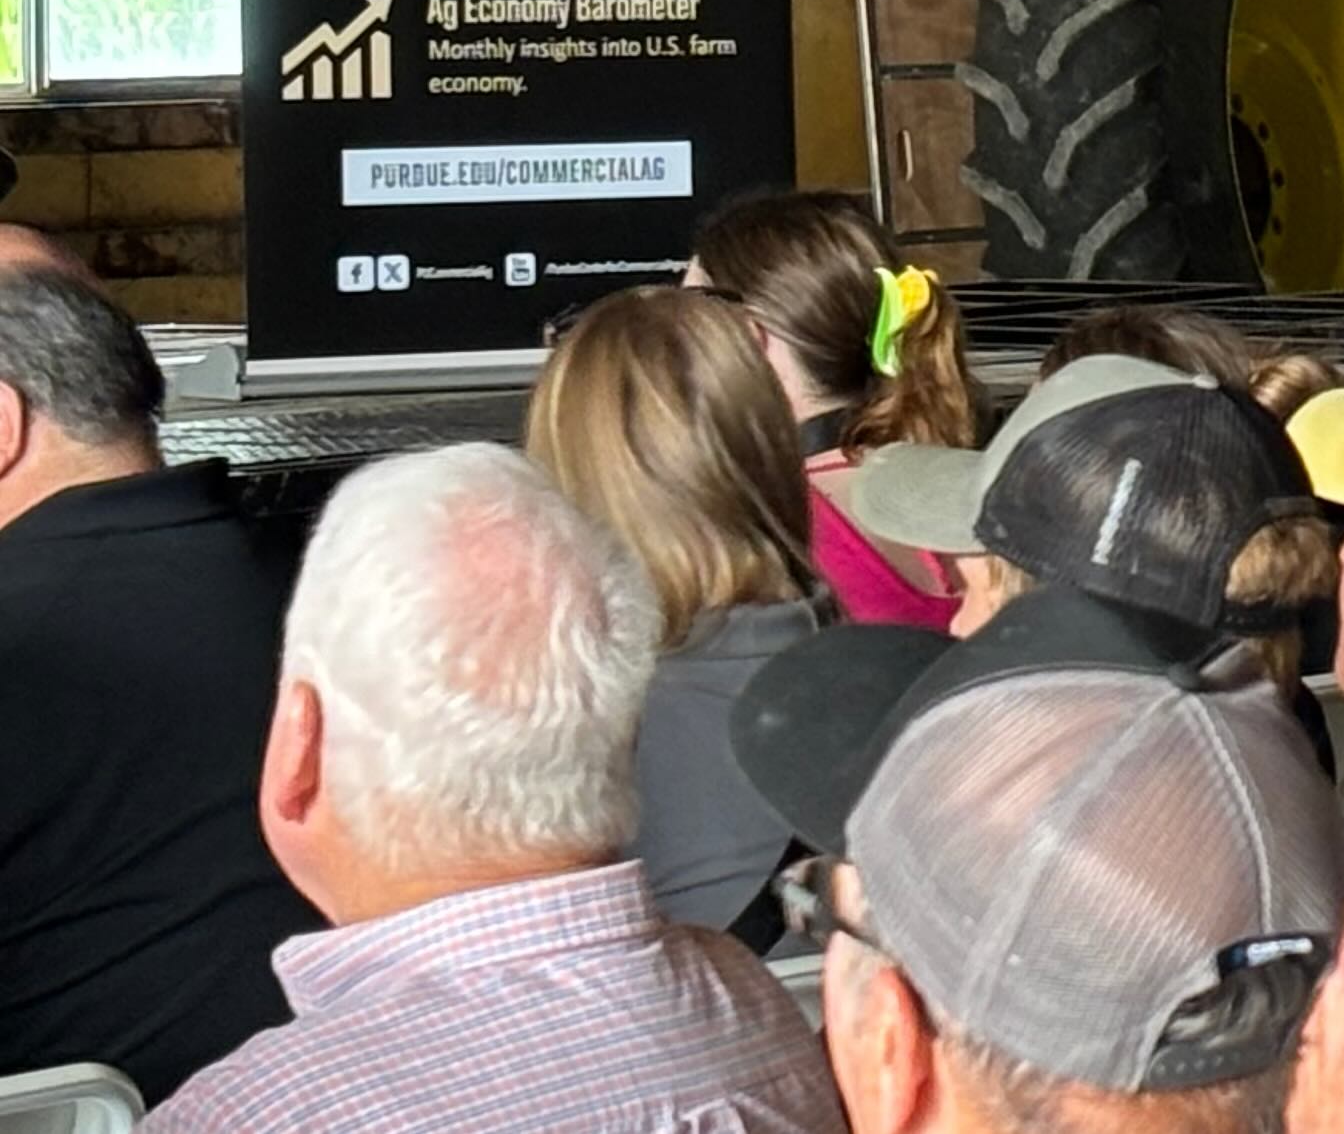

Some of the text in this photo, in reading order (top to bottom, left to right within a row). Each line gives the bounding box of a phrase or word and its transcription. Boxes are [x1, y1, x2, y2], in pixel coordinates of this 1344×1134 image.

[428, 33, 737, 63] Monthly insights into U.S. farm
[428, 76, 528, 96] economy.
[370, 156, 665, 189] PURDUE.EDU/COMMERCIALAG
